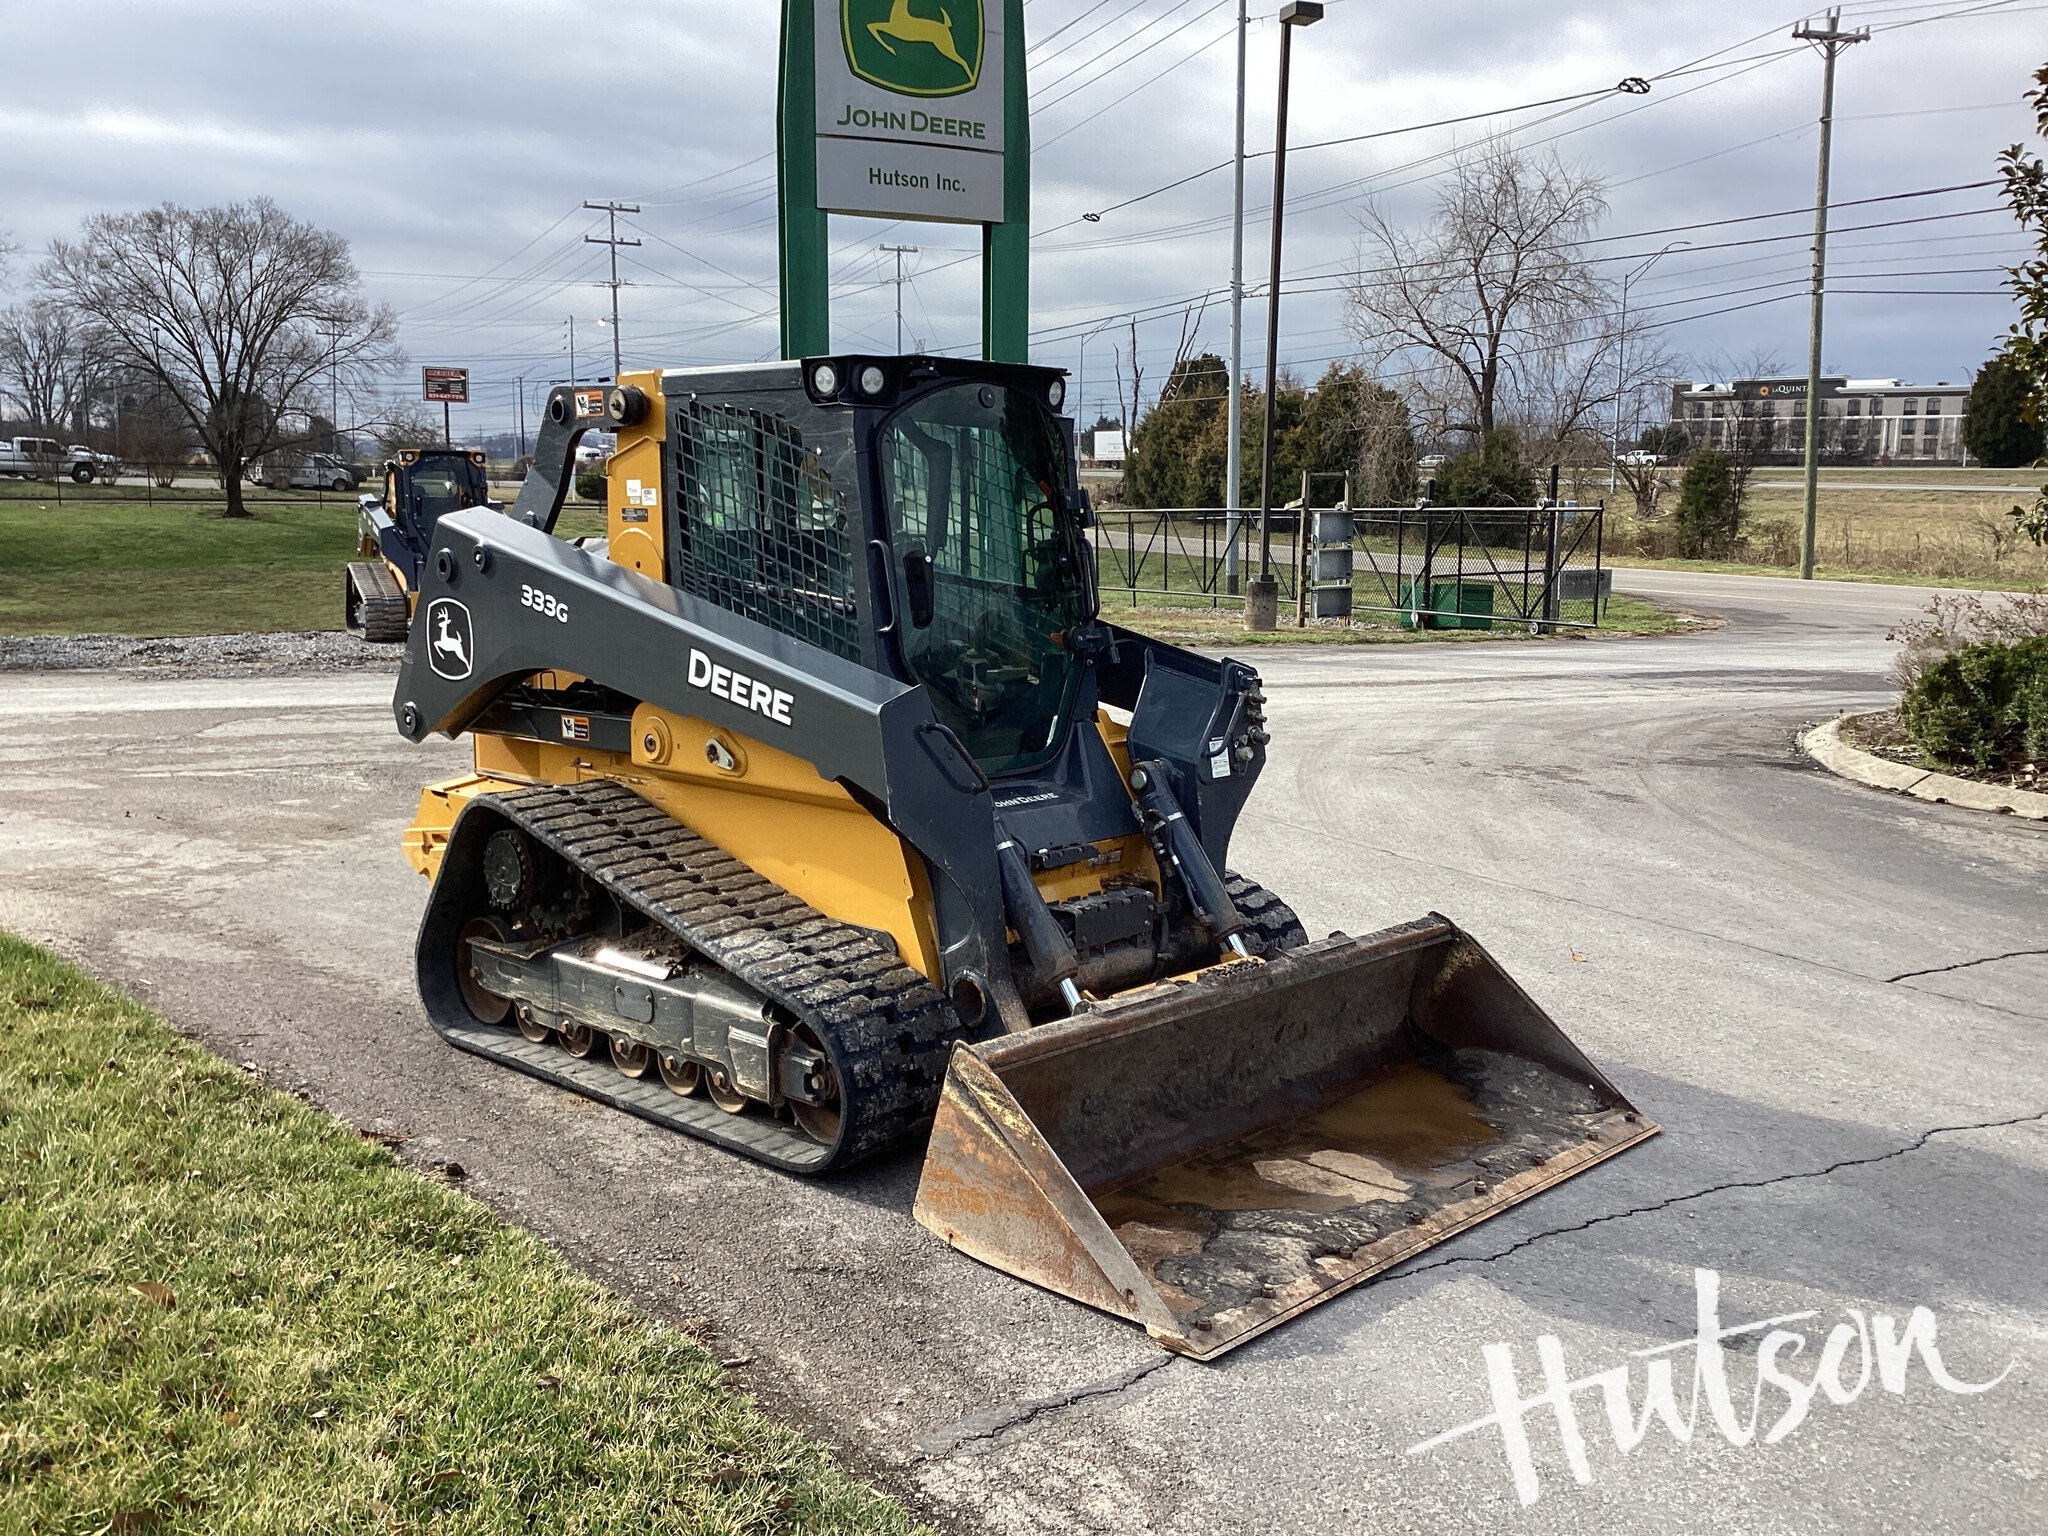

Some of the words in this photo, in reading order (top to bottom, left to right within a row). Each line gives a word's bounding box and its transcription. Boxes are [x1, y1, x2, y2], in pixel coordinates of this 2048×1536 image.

[837, 105, 905, 131] JOHN
[910, 110, 986, 140] DEERE
[869, 167, 929, 189] Hutson
[936, 173, 966, 193] Inc.
[520, 584, 569, 624] 333G
[688, 648, 794, 726] DEERE
[994, 798, 1020, 808] OHN
[1016, 792, 1059, 804] DEERE
